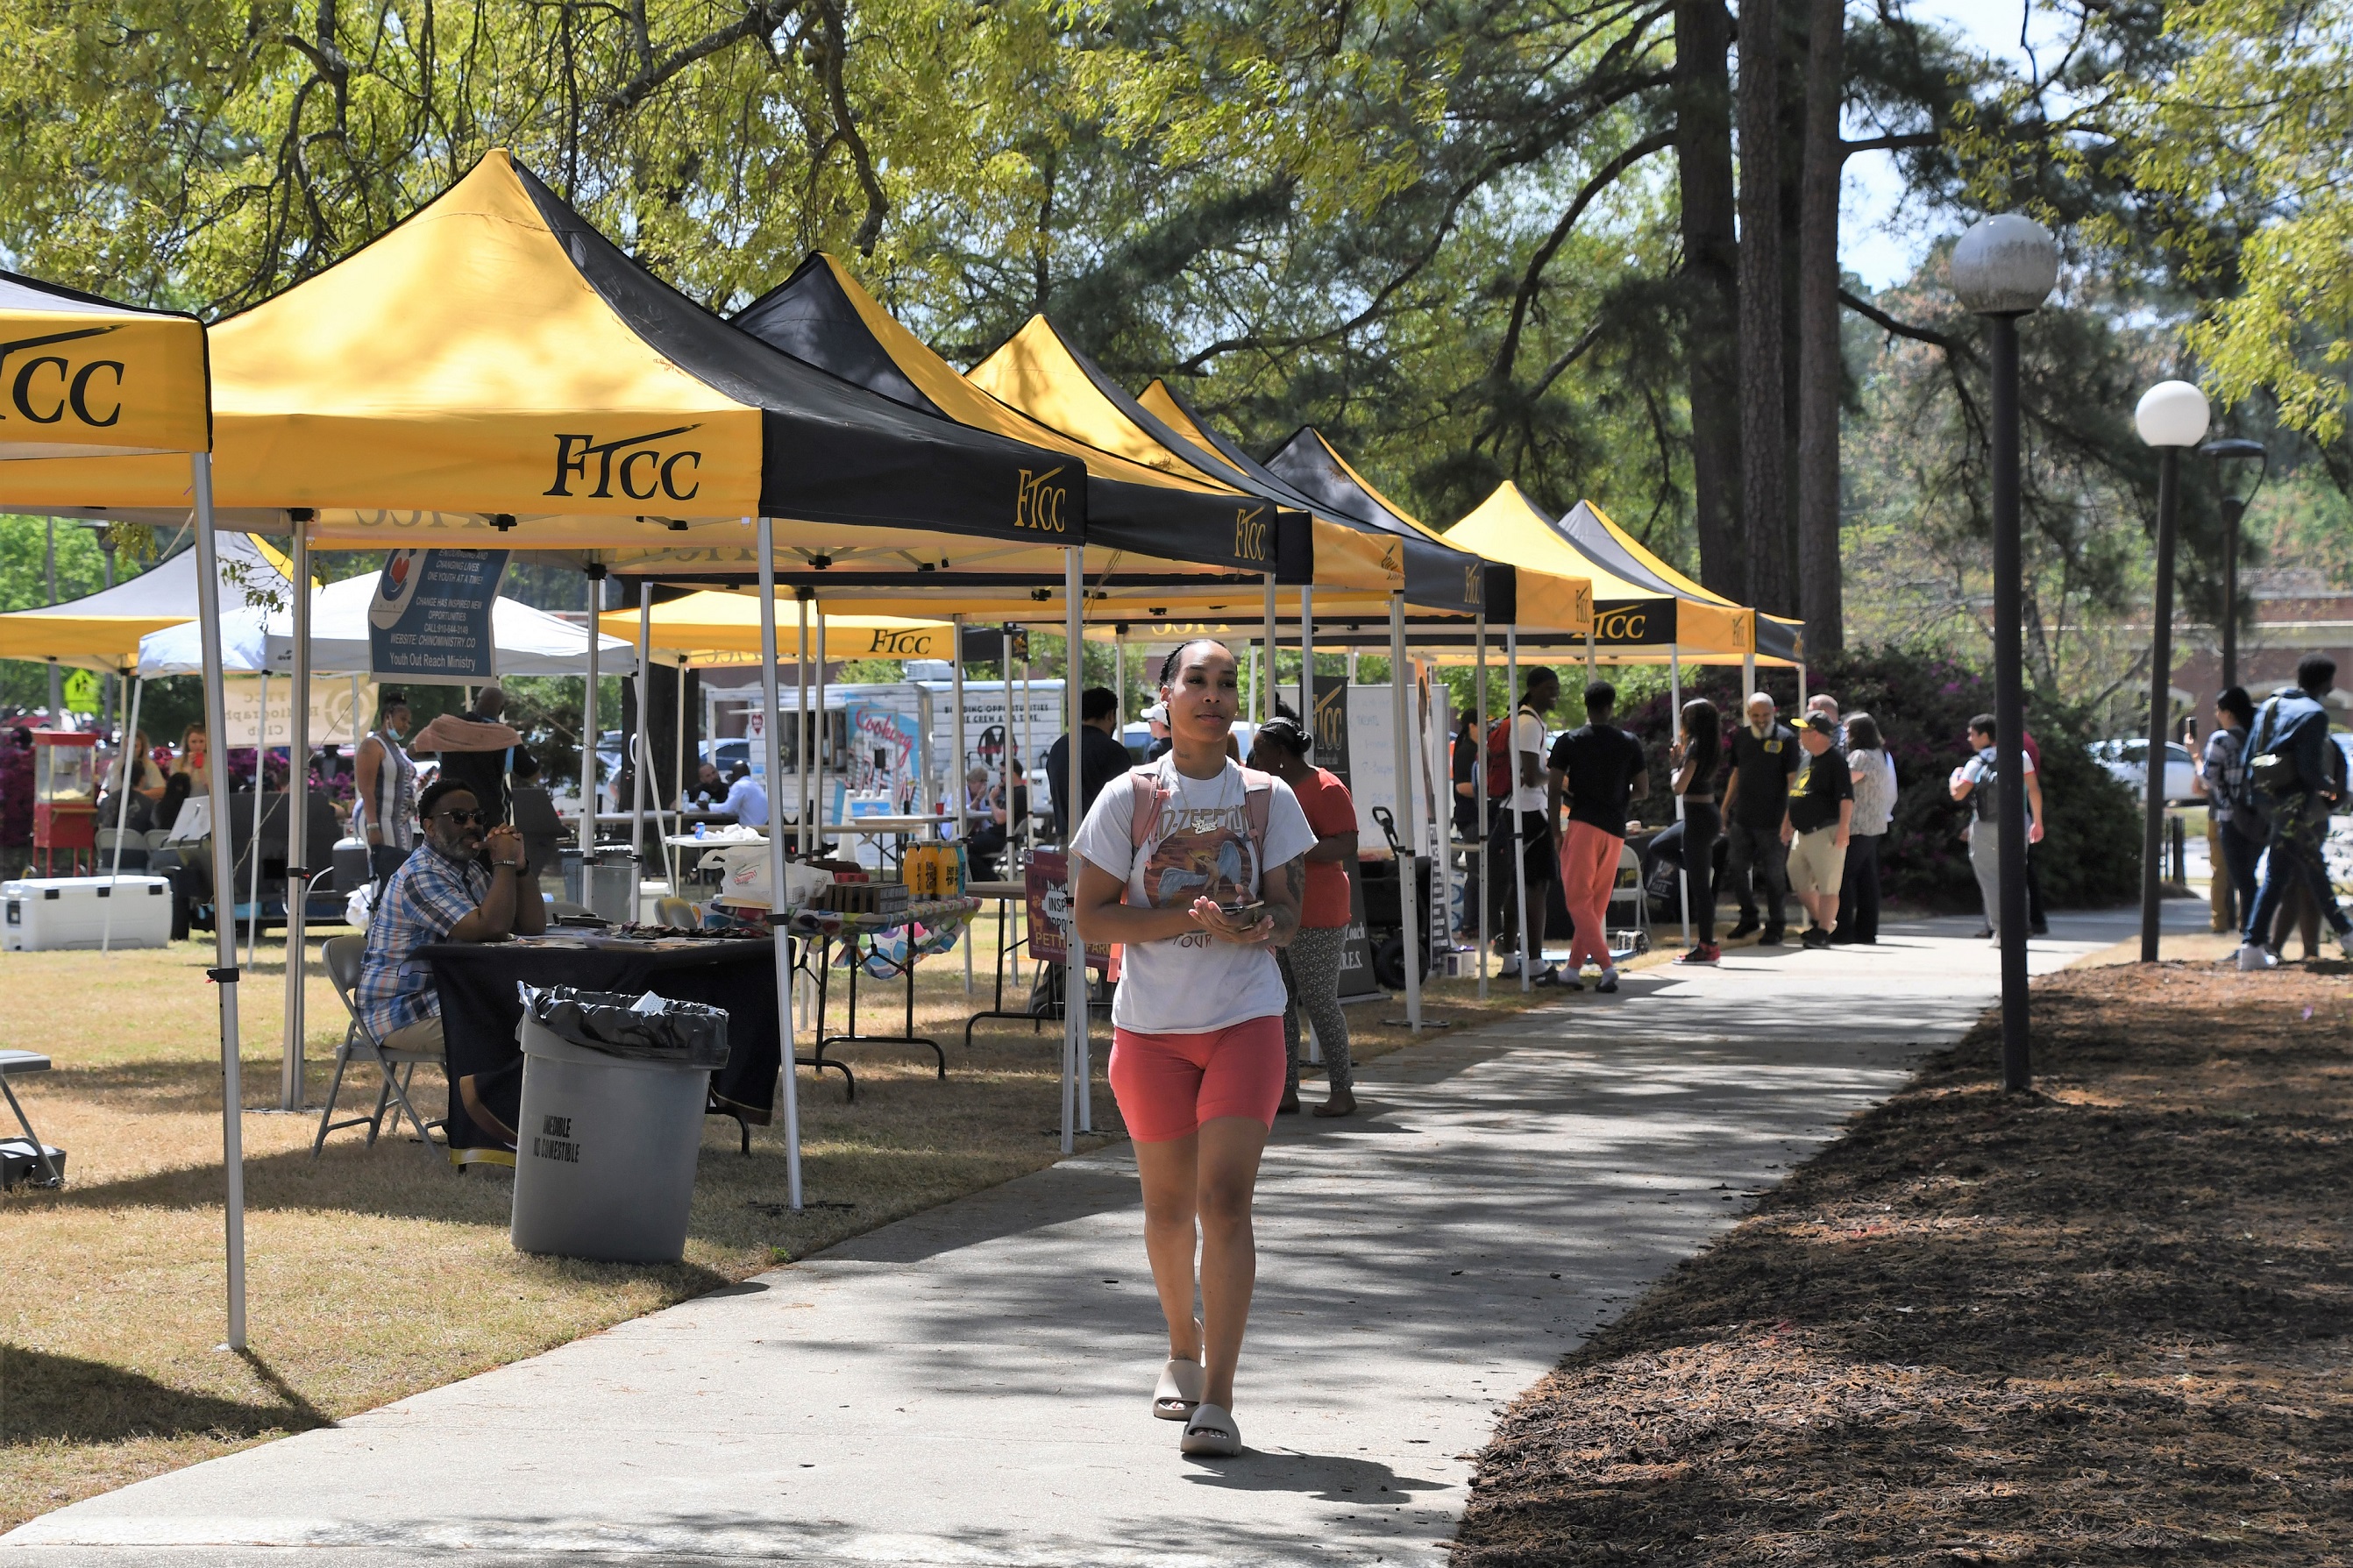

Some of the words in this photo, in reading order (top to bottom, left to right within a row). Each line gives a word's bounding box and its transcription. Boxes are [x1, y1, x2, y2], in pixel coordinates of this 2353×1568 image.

[0, 324, 130, 427] TCC
[543, 423, 707, 500] FTCC
[1013, 465, 1066, 533] FTCC
[1234, 504, 1266, 561] FTCC
[438, 572, 456, 582] YOUTH
[1464, 563, 1480, 604] FTCC
[416, 597, 437, 607] CHANGE
[437, 598, 448, 607] HAS
[448, 599, 471, 609] INSPIRED
[471, 600, 483, 609] NEW
[429, 610, 466, 621] OPPORTUNITIES
[1575, 585, 1590, 624] FTCC
[1571, 603, 1646, 639] TCC
[869, 627, 932, 655] FTCC
[390, 652, 409, 665] Youth
[409, 653, 422, 666] Out
[423, 654, 446, 667] Reach
[447, 655, 475, 671] Ministry
[543, 1115, 572, 1139] INEDIBLE
[541, 1139, 580, 1163] COMESTIBLE
